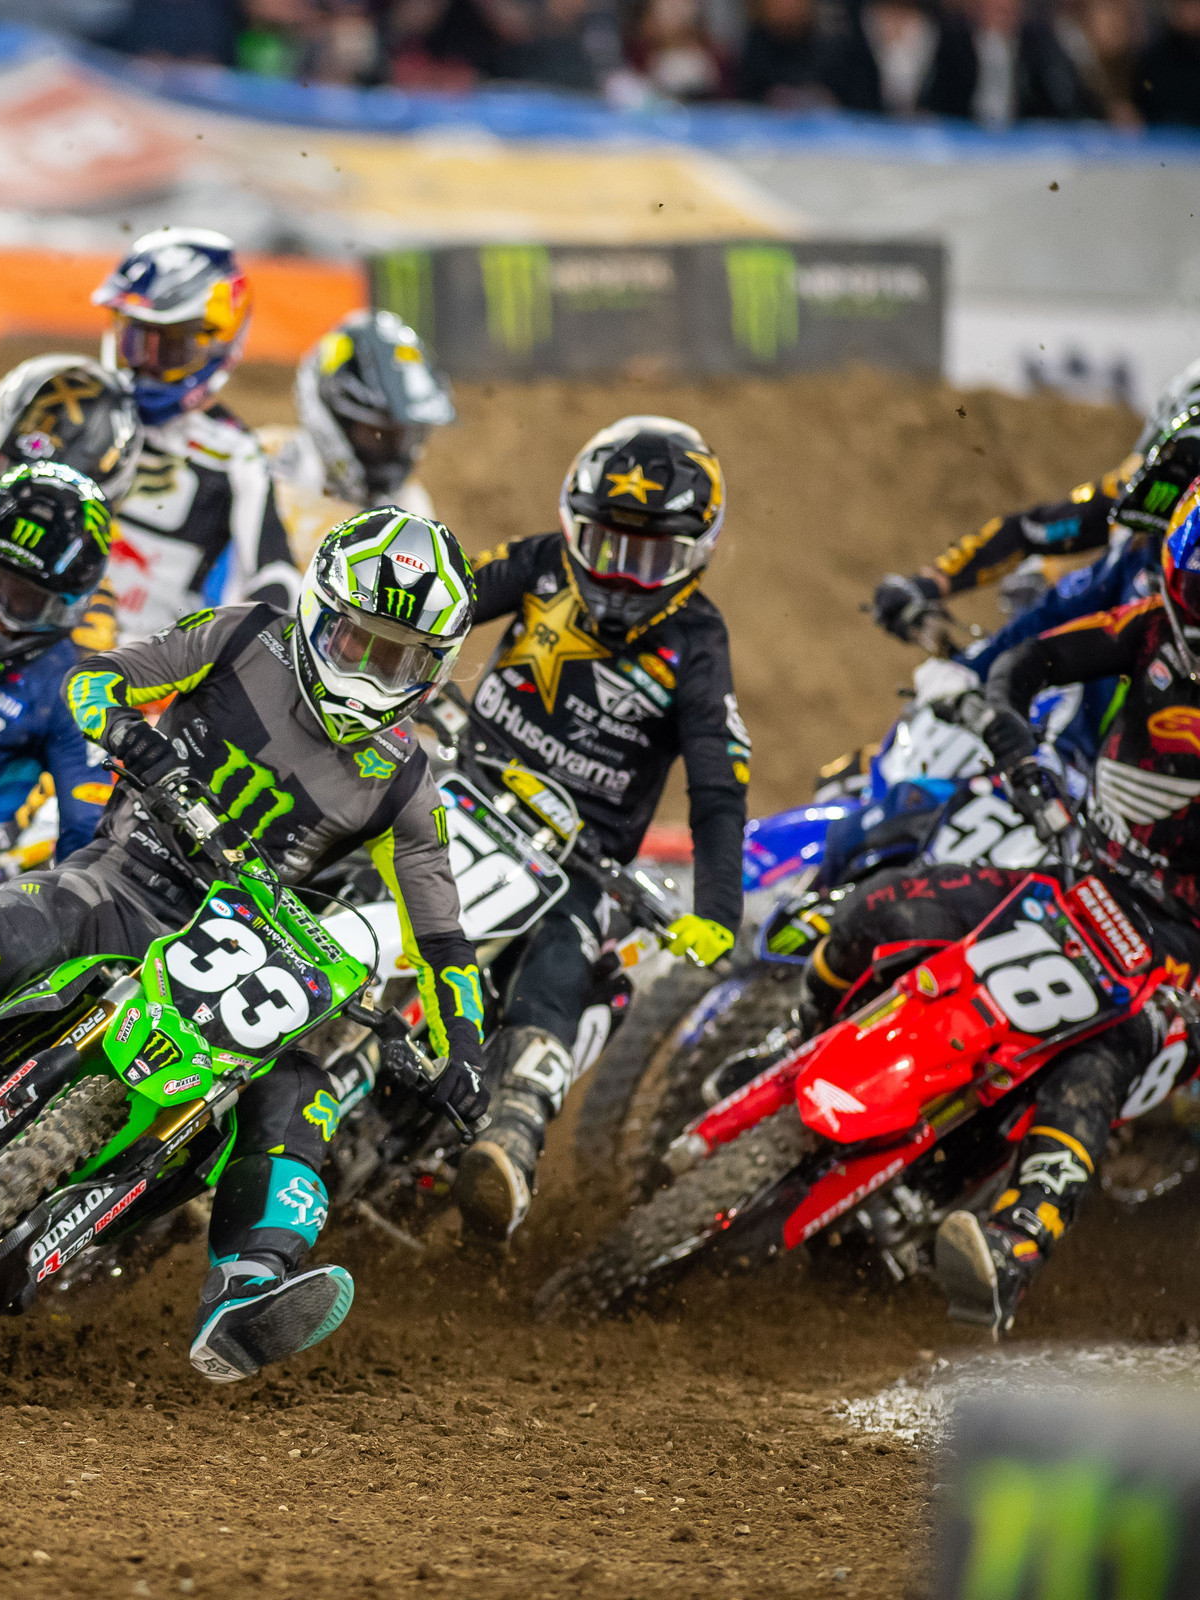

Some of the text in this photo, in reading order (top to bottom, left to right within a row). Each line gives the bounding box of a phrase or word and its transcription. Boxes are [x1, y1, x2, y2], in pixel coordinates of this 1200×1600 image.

[395, 554, 426, 571] BELL
[494, 697, 632, 790] Husqvarna
[166, 917, 310, 1049] 33
[965, 919, 1099, 1033] 18
[71, 1007, 107, 1042] PRO
[95, 1179, 147, 1235] BRAKING
